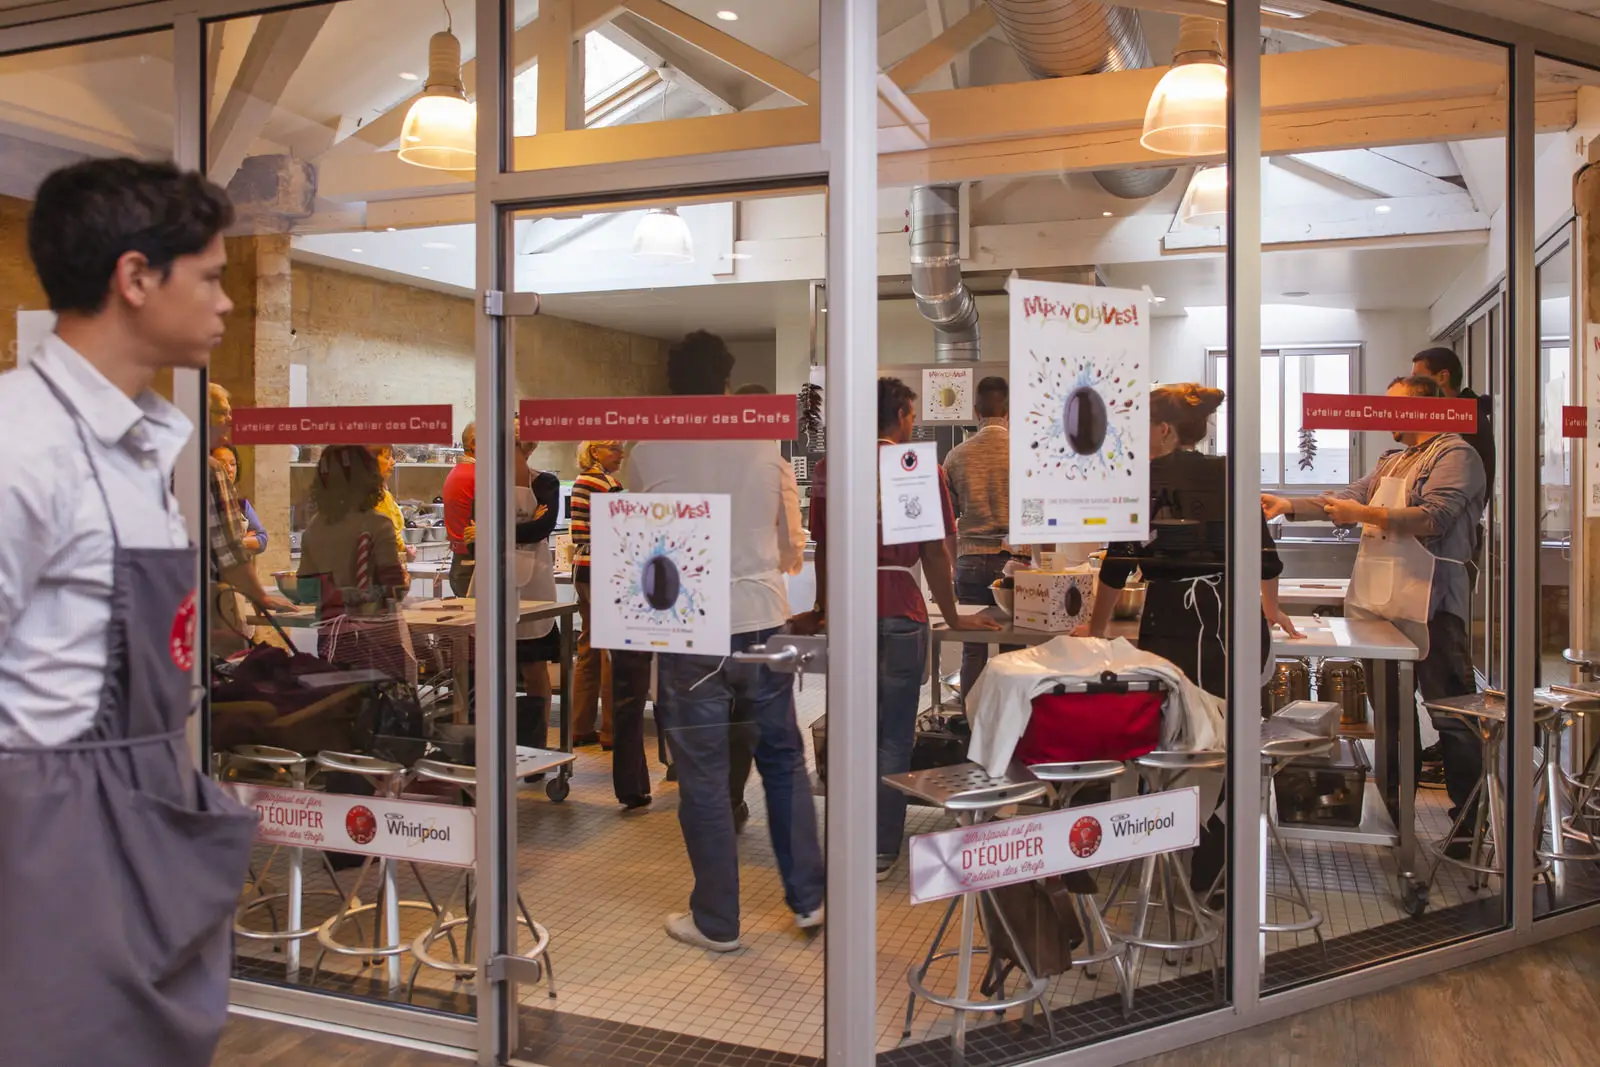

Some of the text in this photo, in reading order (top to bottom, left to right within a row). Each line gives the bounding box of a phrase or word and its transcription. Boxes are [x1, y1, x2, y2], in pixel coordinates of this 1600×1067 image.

[524, 409, 790, 426] L'atelier des Chefs L'atelier des Chefs
[1344, 408, 1361, 418] des
[1363, 405, 1392, 418] Chefs
[1430, 411, 1445, 420] des
[1447, 409, 1473, 421] Chefs
[278, 423, 298, 432] des
[300, 418, 336, 432] Chefs
[385, 420, 407, 430] des
[409, 416, 448, 430] Chefs
[386, 820, 450, 843] Whirlpool
[1112, 811, 1175, 837] Whirlpool
[962, 837, 1044, 870] D'ÉQUIPER
